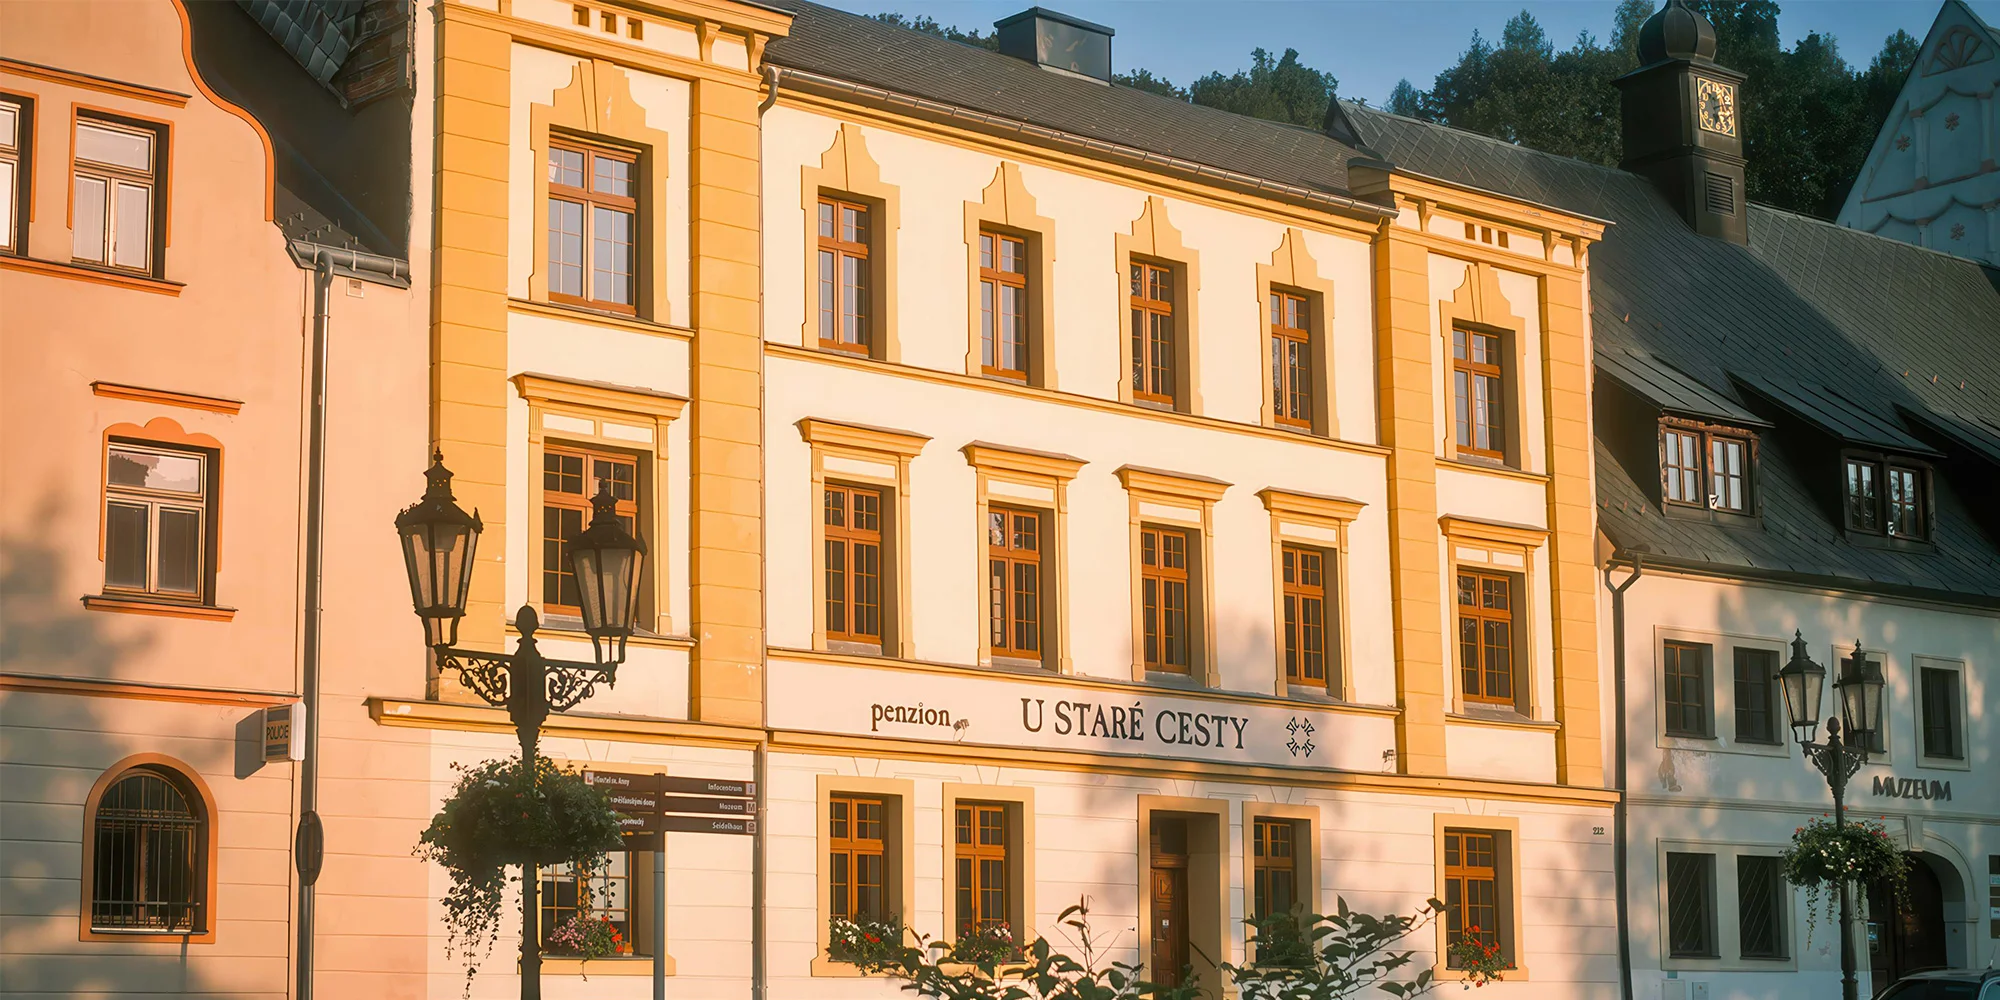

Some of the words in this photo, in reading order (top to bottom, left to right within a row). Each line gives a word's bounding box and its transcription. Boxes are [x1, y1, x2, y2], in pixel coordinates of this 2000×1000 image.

[871, 702, 951, 732] penzion
[1020, 697, 1045, 733] U
[1054, 700, 1145, 742] STARÉ
[1155, 710, 1250, 750] CESTY
[707, 783, 743, 792] Infocentrum
[1873, 775, 1952, 802] MUZEUM
[719, 803, 743, 811] Muzeum
[712, 821, 743, 831] Seidelhaus
